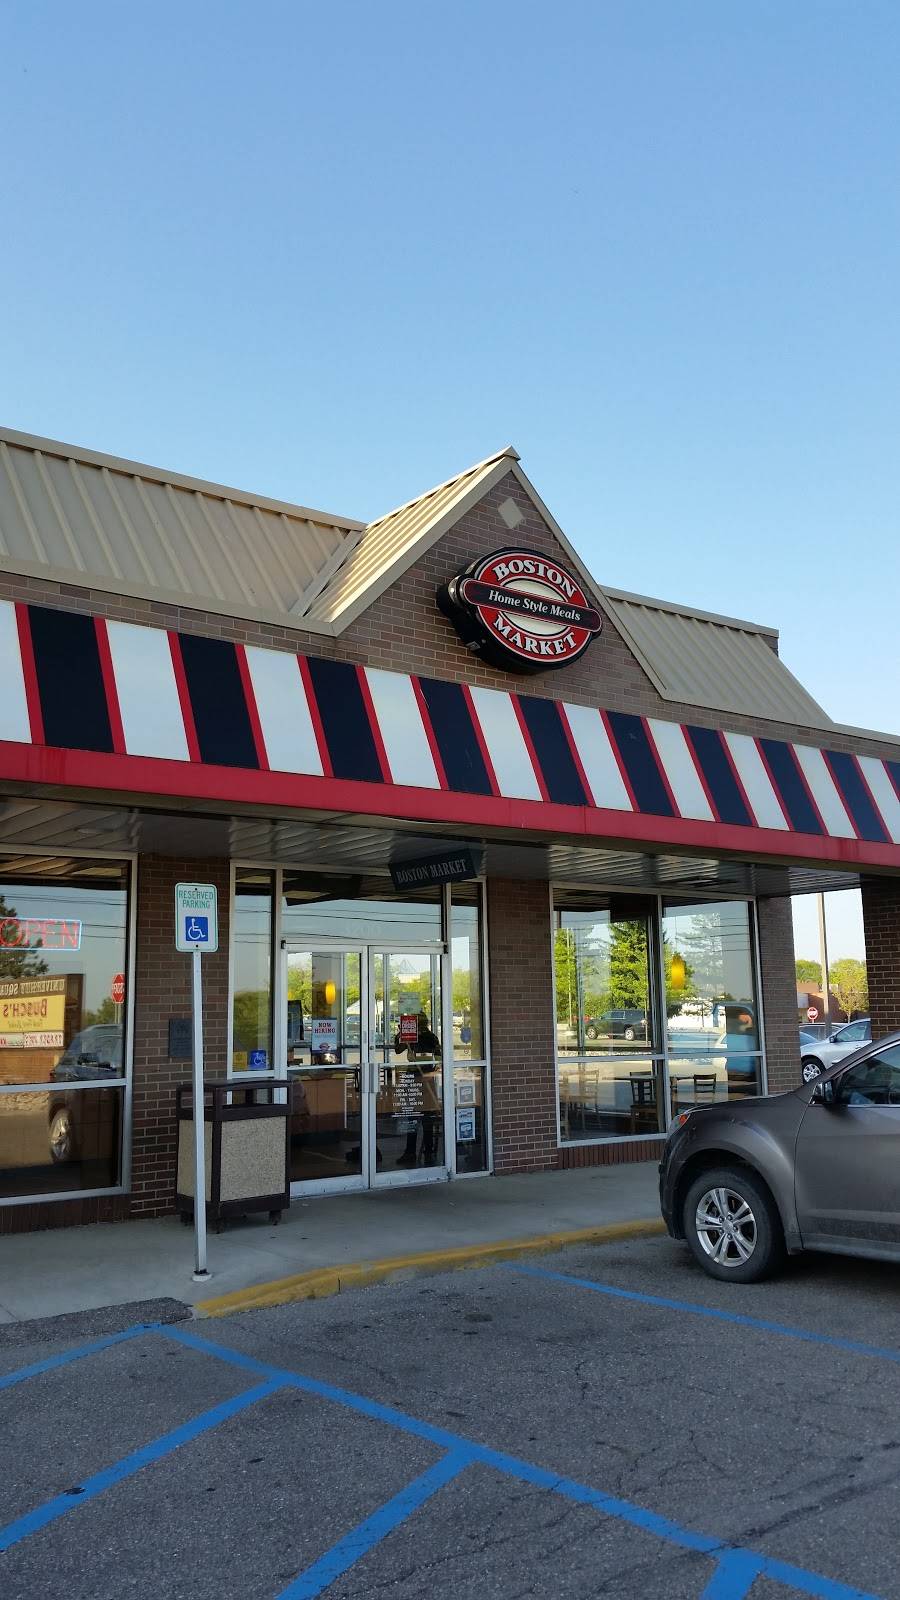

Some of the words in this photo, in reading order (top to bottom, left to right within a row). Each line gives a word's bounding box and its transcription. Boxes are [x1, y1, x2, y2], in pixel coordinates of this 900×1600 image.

[493, 559, 577, 598] BOSTON
[489, 590, 520, 607] Home
[522, 598, 548, 613] Style
[550, 604, 581, 621] Meals
[493, 614, 577, 655] MARKET
[395, 864, 430, 884] BOSTON
[430, 859, 466, 878] MARKET
[178, 890, 214, 900] RESERVED
[182, 900, 210, 909] PARKING
[0, 918, 78, 947] OPEN
